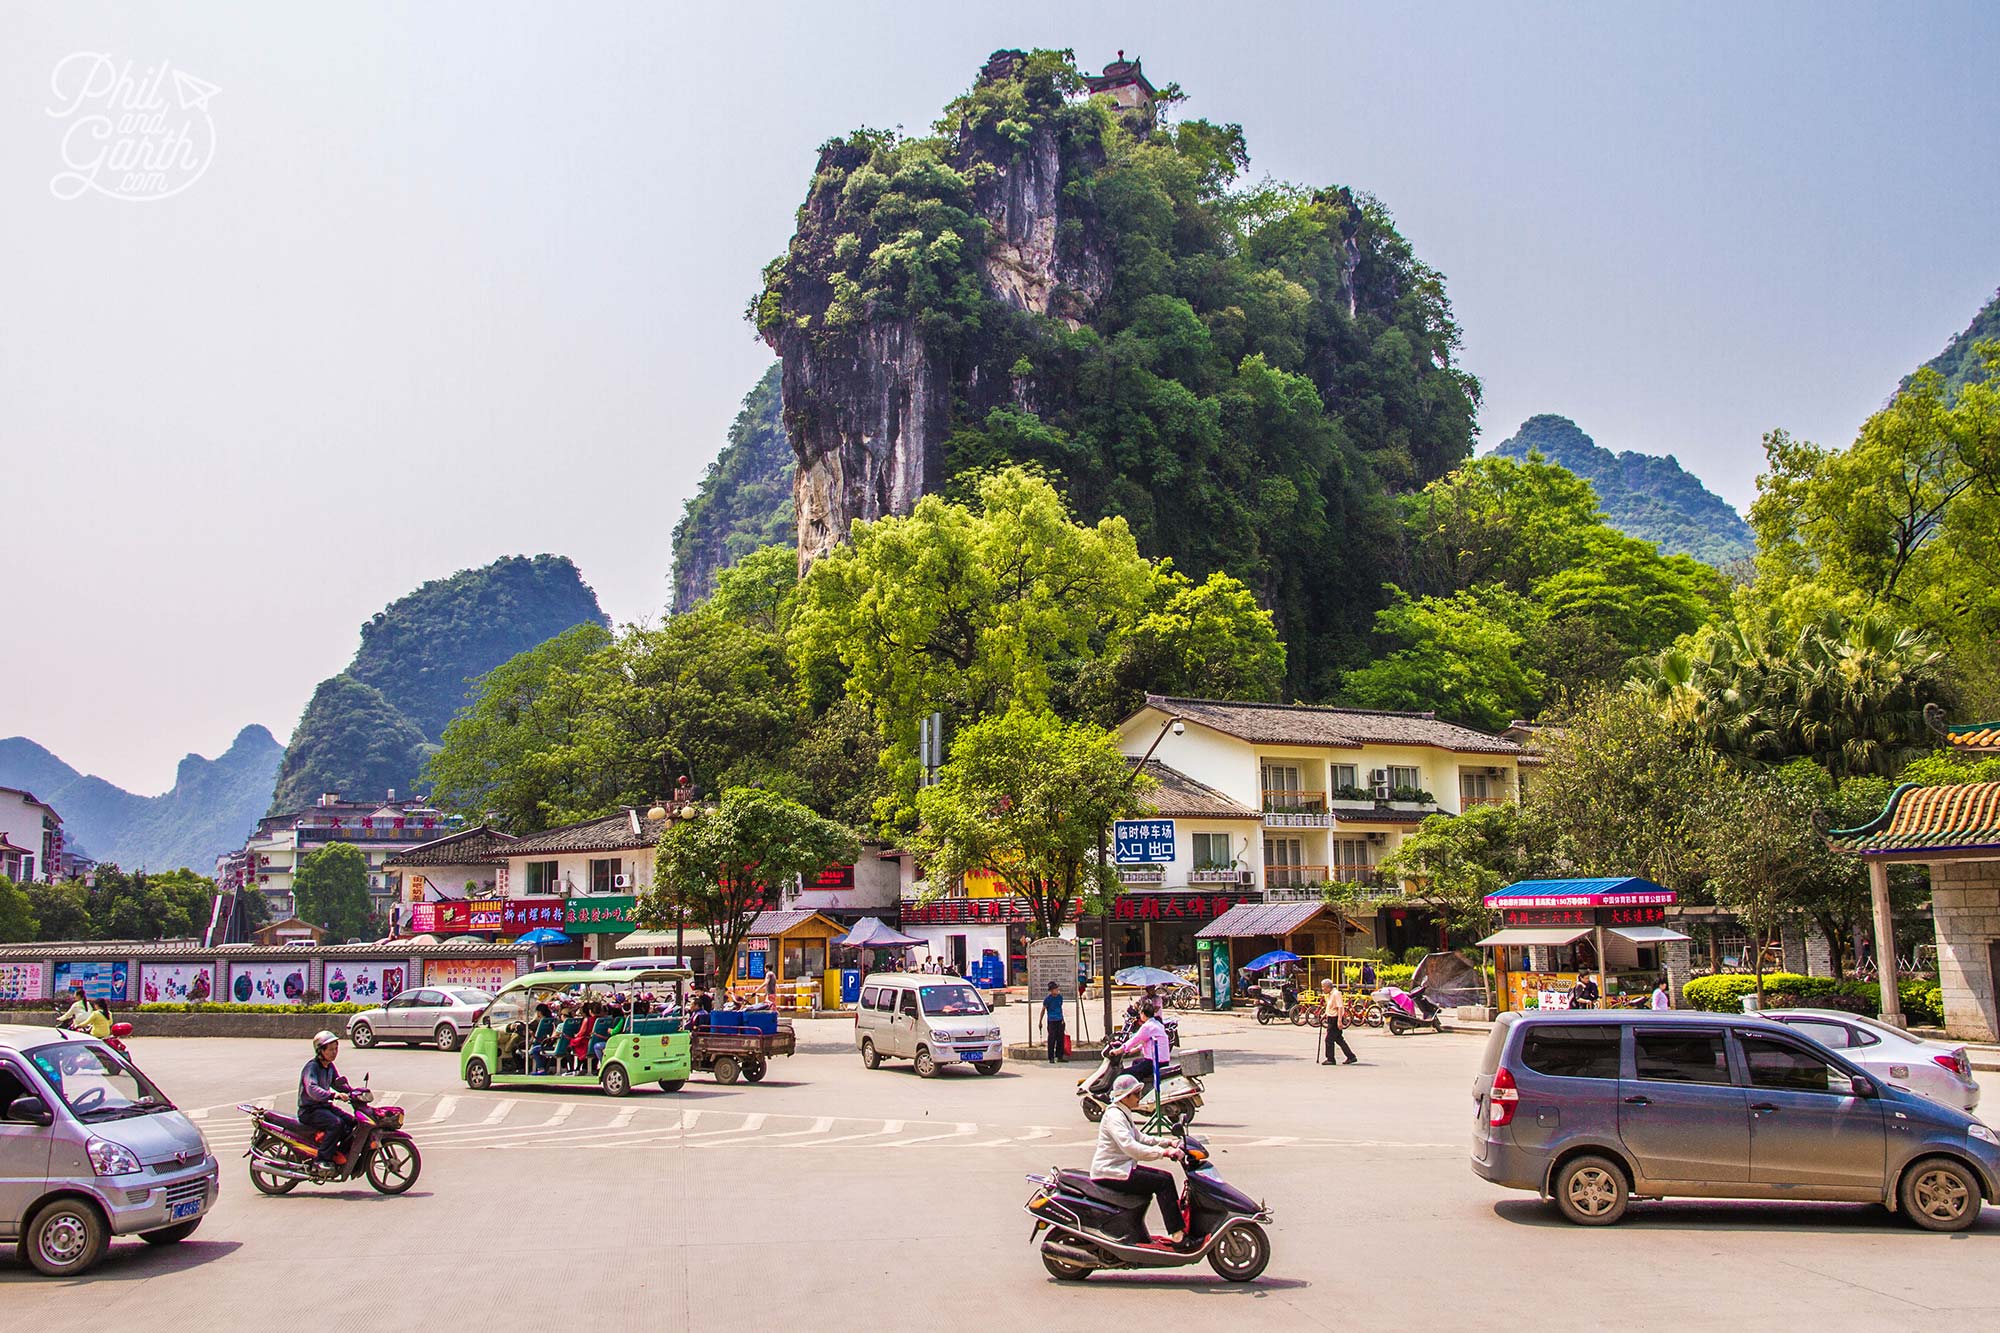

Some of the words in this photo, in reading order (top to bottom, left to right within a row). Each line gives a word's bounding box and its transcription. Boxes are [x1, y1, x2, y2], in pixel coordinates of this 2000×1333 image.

[1117, 824, 1172, 840] 临时停车场
[1116, 842, 1143, 856] 入口
[1149, 841, 1174, 856] 出口
[848, 975, 855, 988] P
